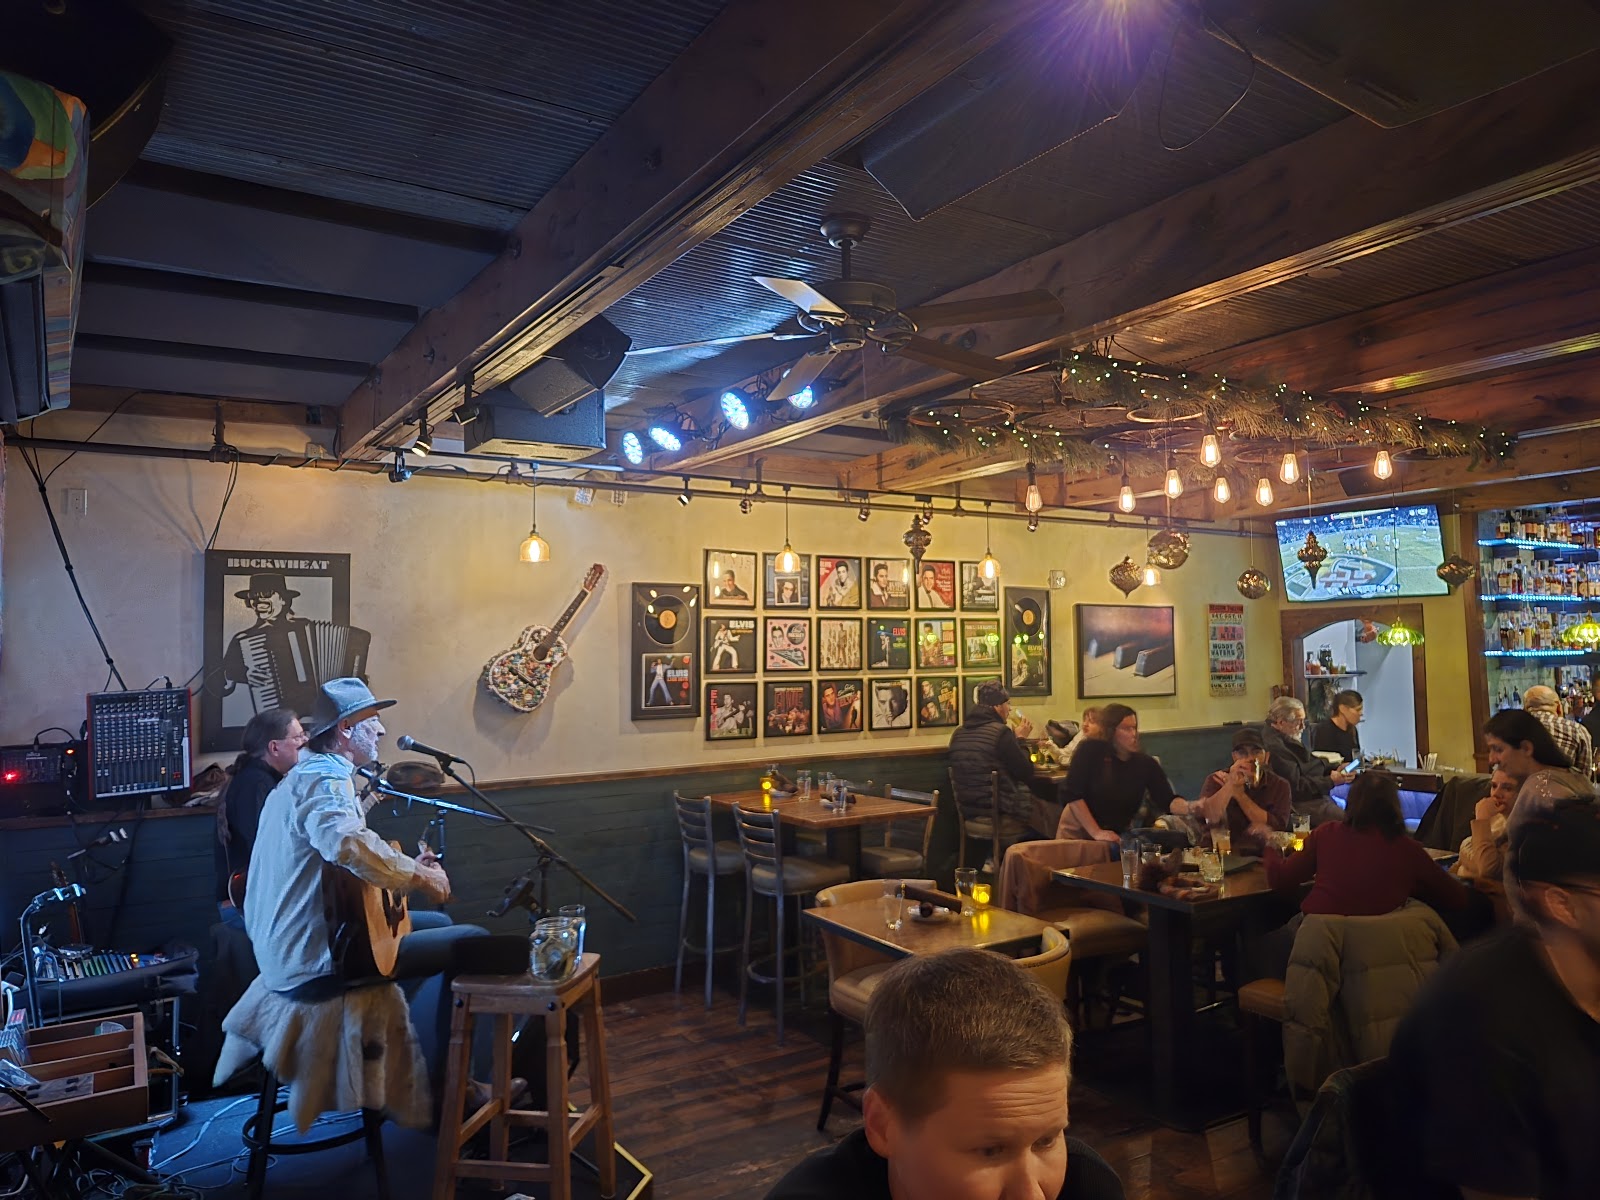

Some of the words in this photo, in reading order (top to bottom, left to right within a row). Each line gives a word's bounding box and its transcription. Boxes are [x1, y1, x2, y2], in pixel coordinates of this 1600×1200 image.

[227, 558, 330, 570] BUCKWHEAT
[729, 620, 755, 629] ELVIS
[892, 627, 906, 636] ELVIS
[667, 669, 689, 678] ELVIS
